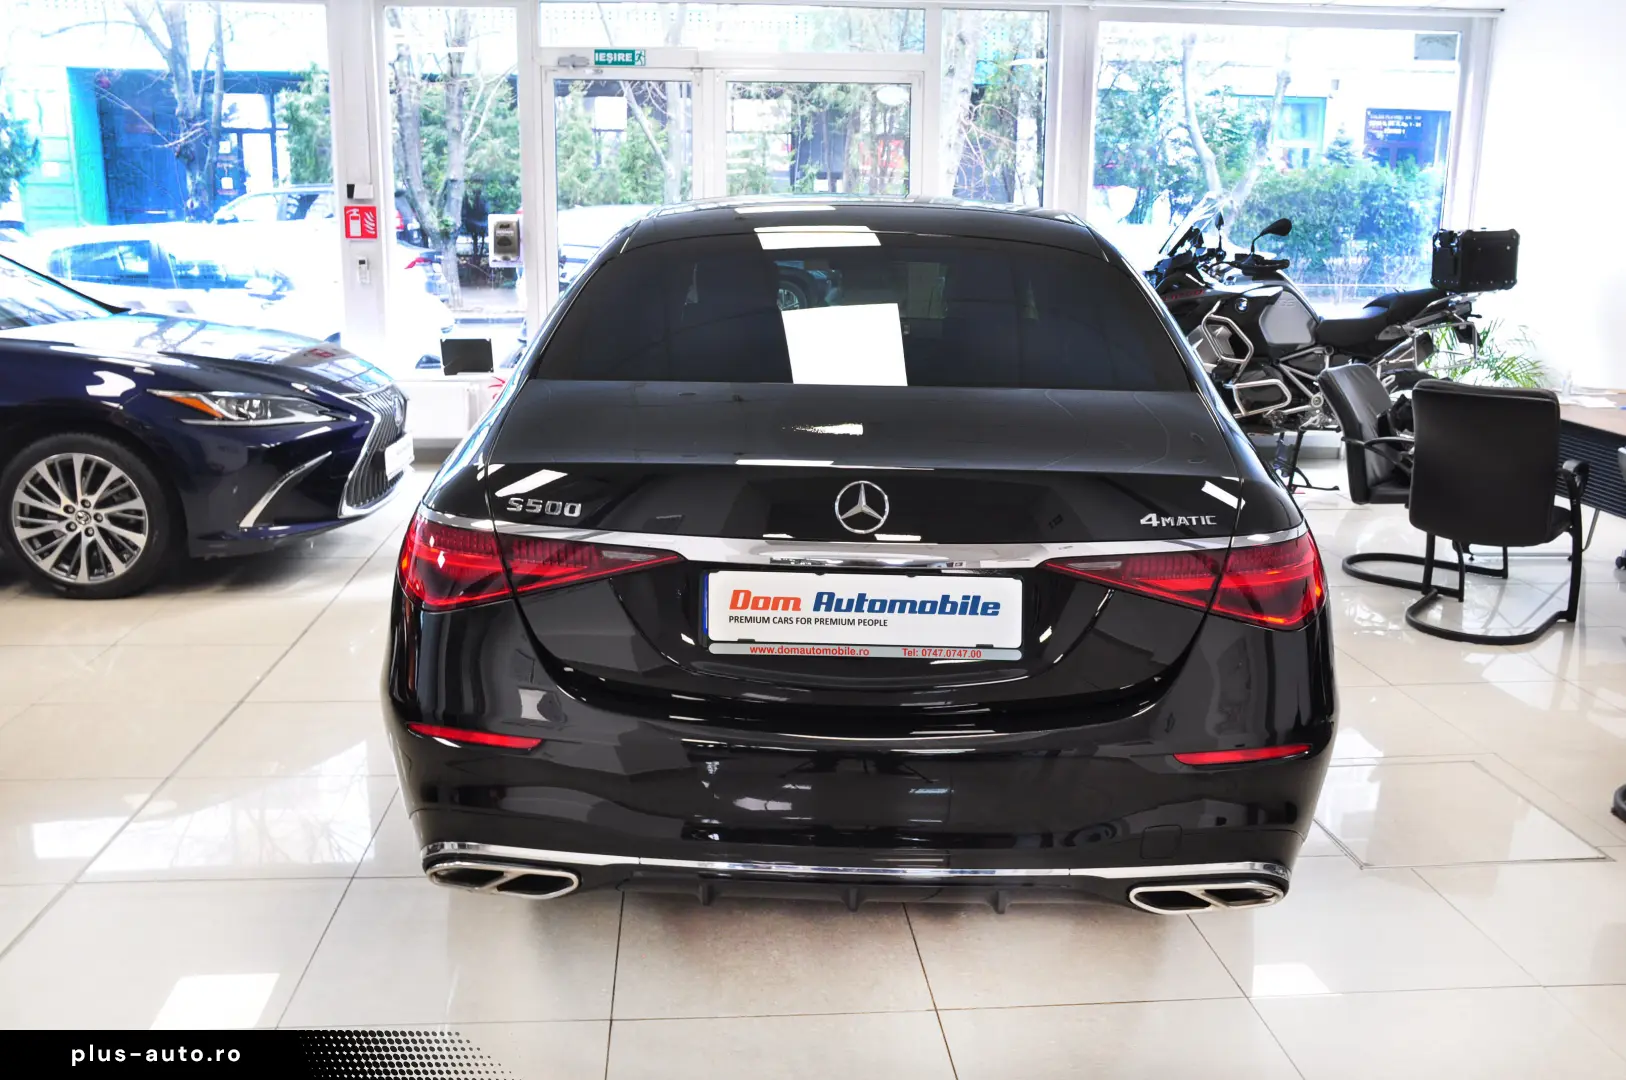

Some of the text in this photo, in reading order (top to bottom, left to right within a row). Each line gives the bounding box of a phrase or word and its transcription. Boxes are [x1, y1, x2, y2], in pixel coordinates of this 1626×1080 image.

[1139, 512, 1218, 527] 4MATIC
[729, 589, 1001, 617] Dom Automobile
[728, 615, 888, 628] PREMIUM CARS FOR PREMIUM PEOPLE
[749, 645, 870, 656] www.domautomobile.ro
[902, 647, 982, 659] Tel: 0747.0747.00
